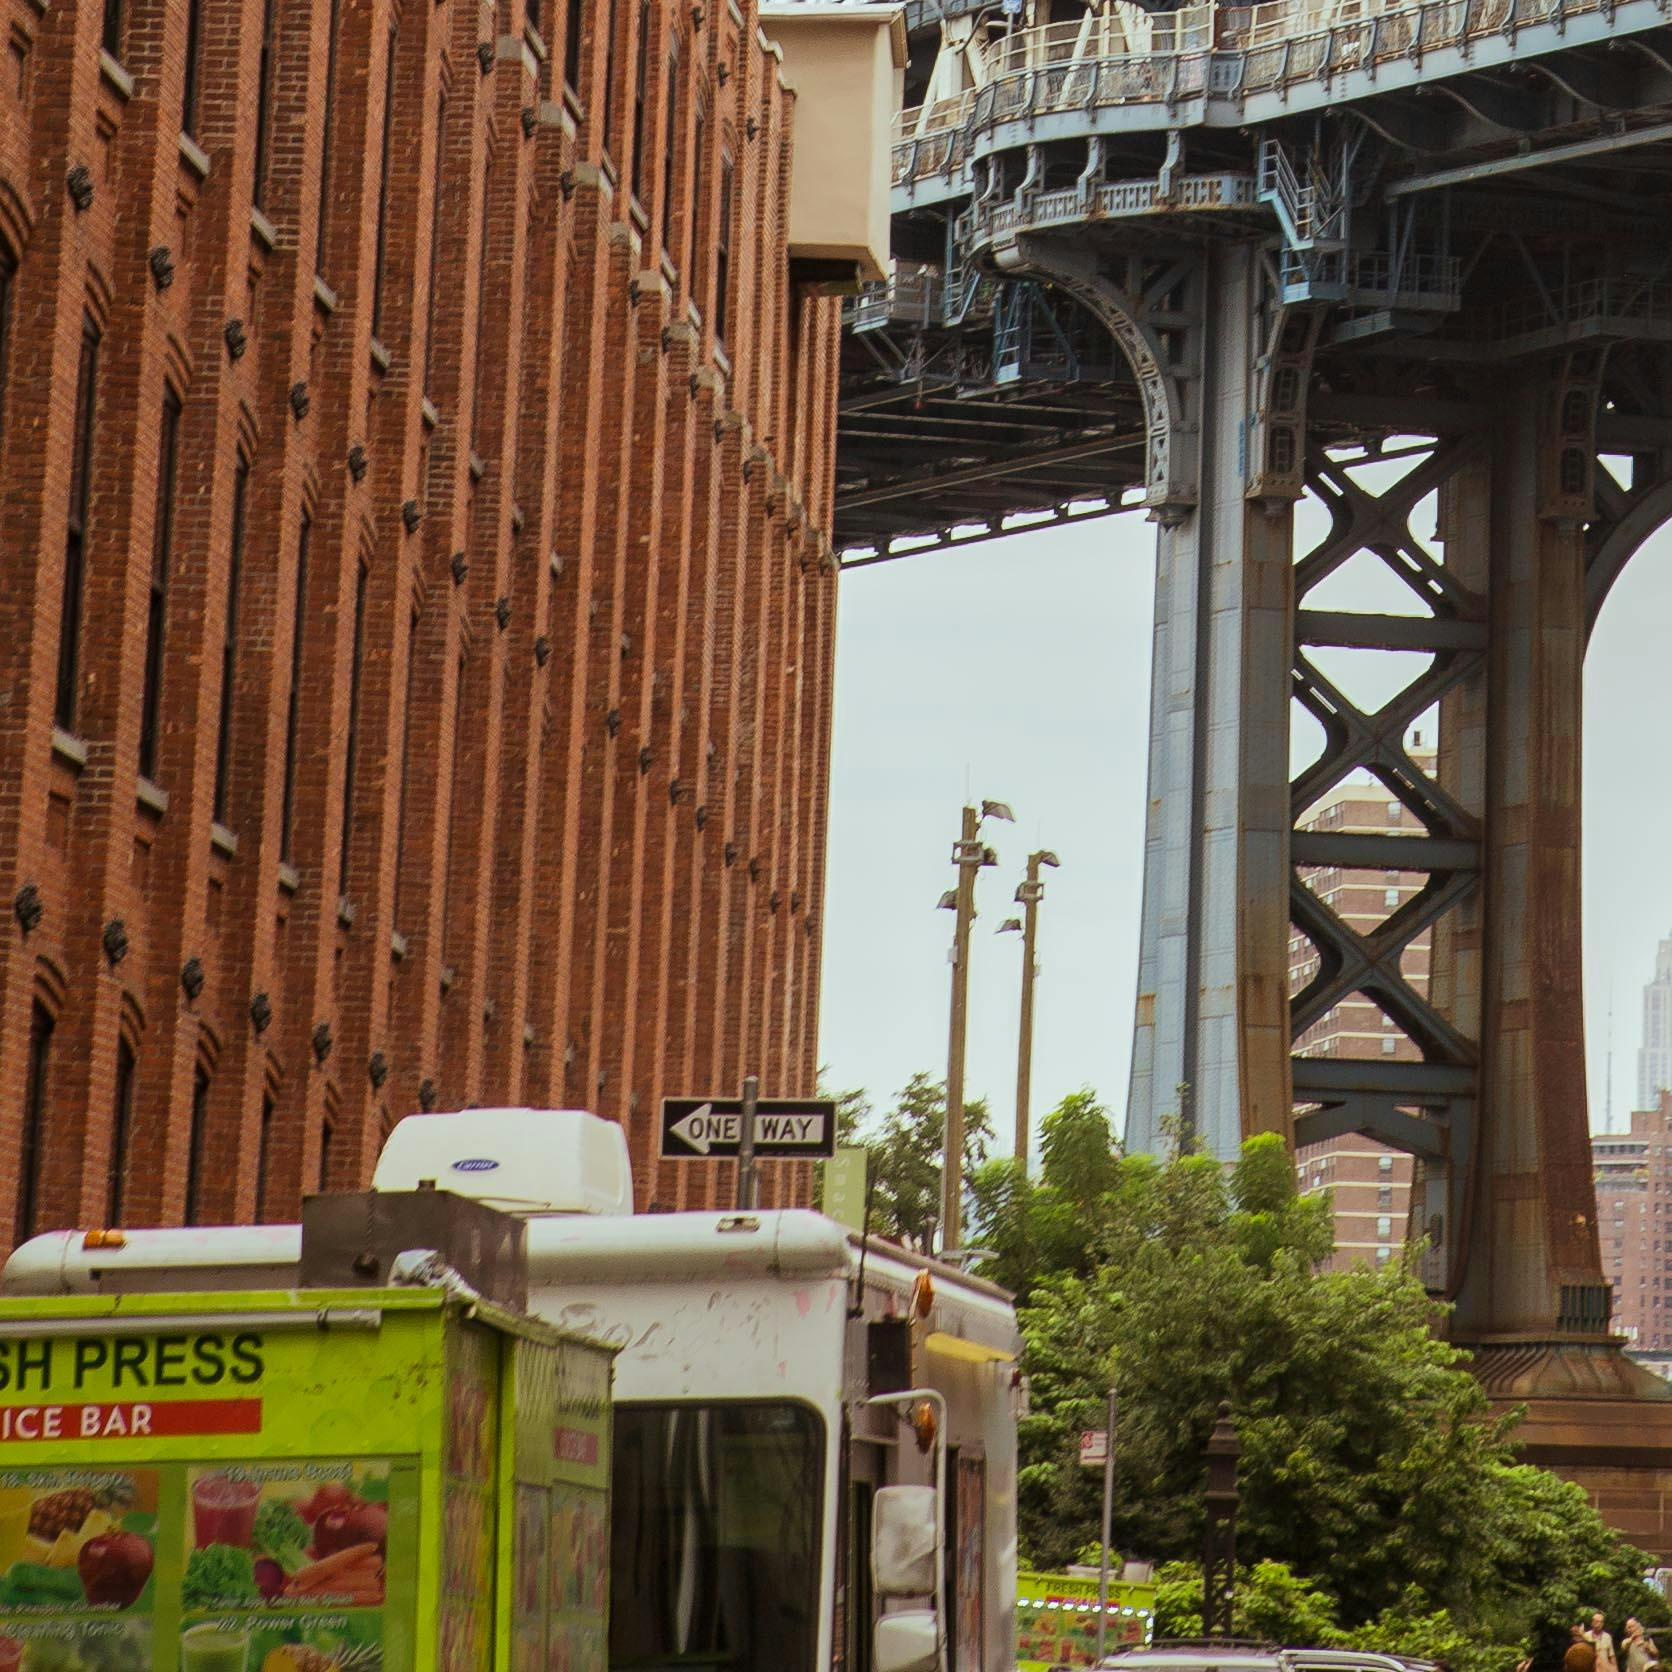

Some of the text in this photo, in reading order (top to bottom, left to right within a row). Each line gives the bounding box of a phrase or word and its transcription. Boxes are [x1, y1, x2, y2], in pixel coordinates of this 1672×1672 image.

[688, 1118, 814, 1141] ONE WAY
[74, 1332, 265, 1388] PRESS
[80, 1404, 152, 1437] BAR
